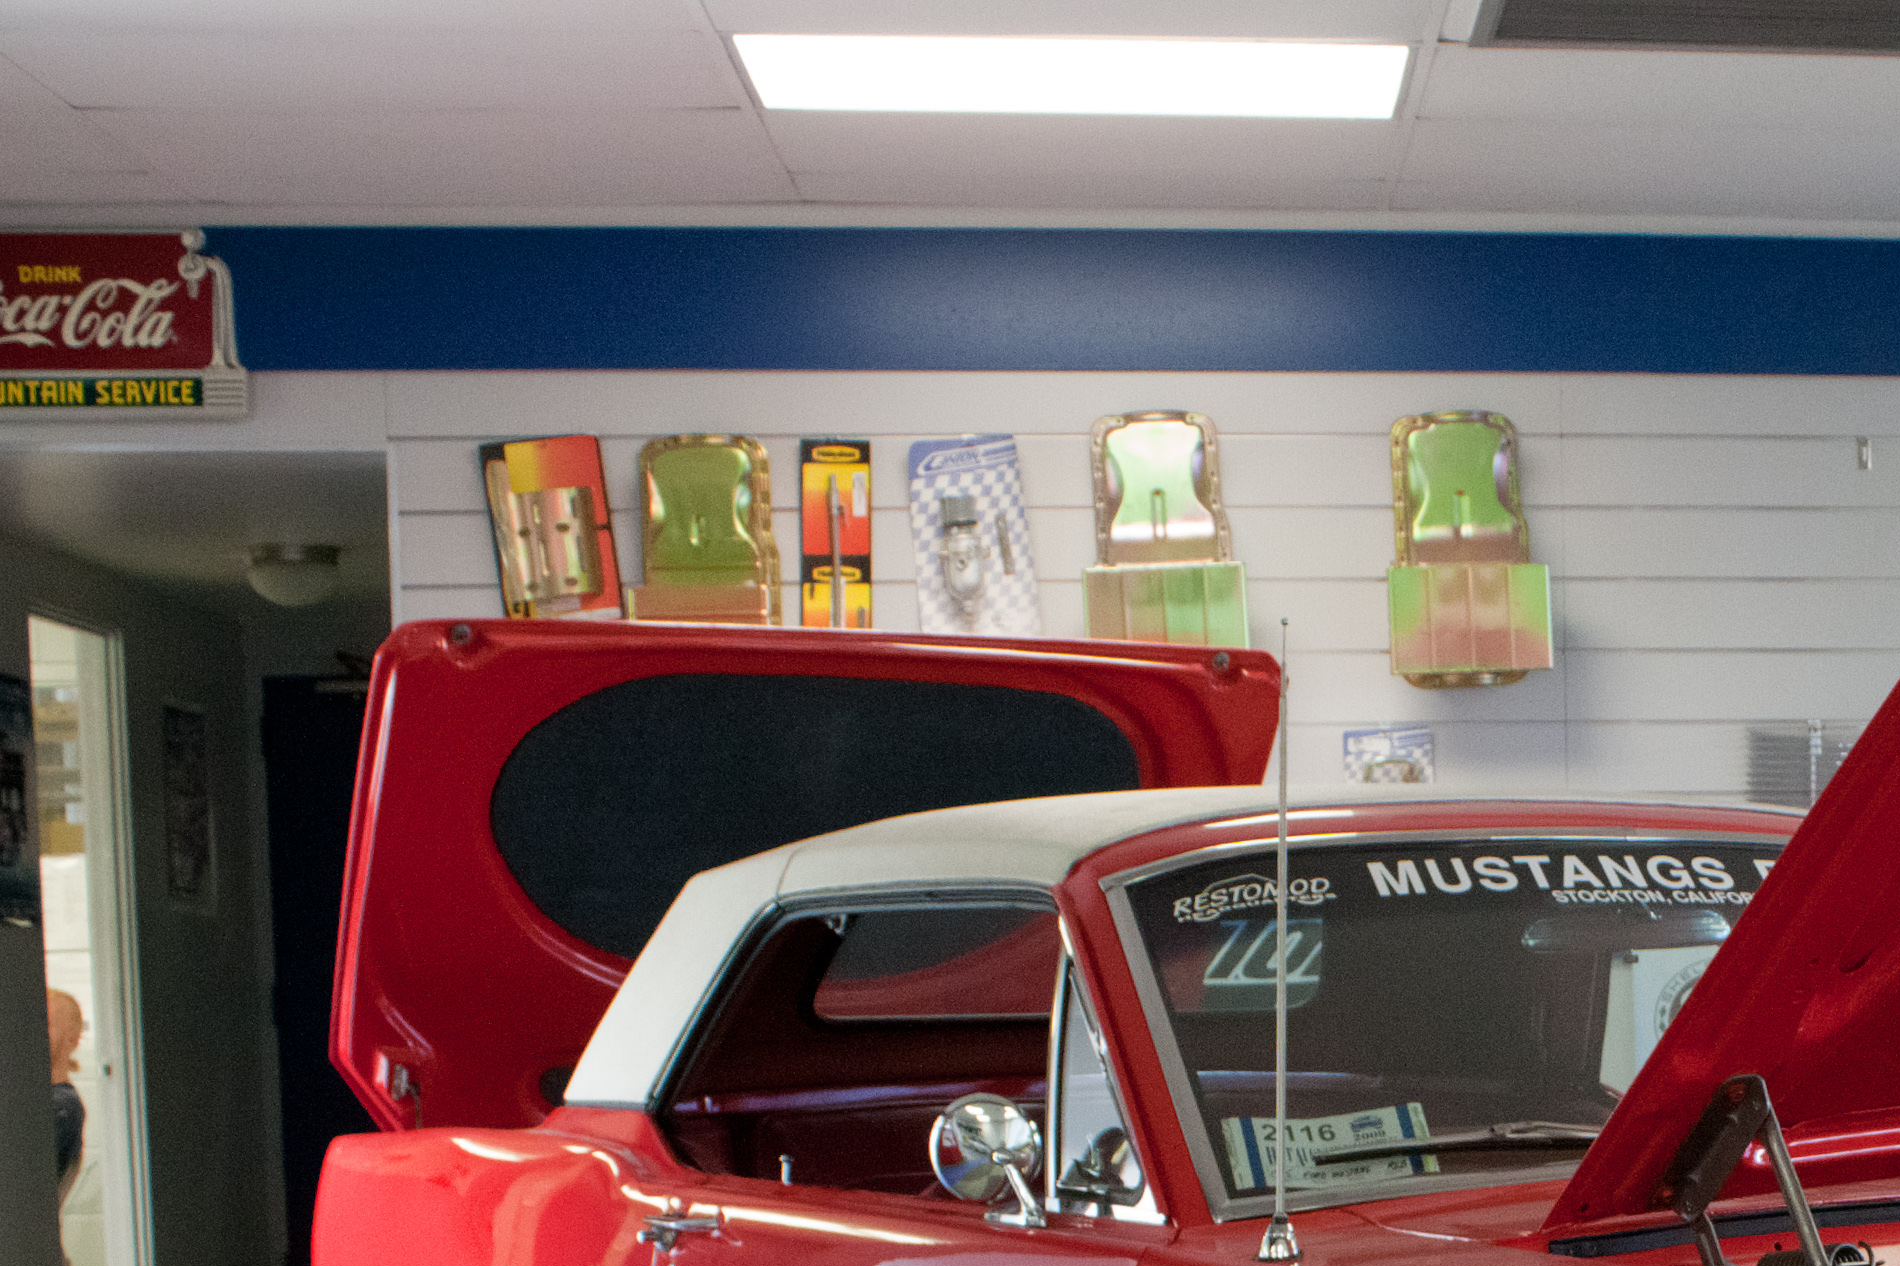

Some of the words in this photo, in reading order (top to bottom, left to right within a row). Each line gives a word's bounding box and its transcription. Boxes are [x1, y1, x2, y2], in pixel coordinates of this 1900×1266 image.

[18, 265, 81, 283] DRINK
[0, 278, 181, 348] ca-Cola
[0, 380, 84, 404] NTAIN
[95, 380, 195, 404] SERVICE
[1366, 855, 1735, 898] MUSTANGS
[1551, 889, 1672, 905] STOCKTON,
[1672, 890, 1755, 905] CALIFOR
[1261, 1123, 1336, 1141] 2116
